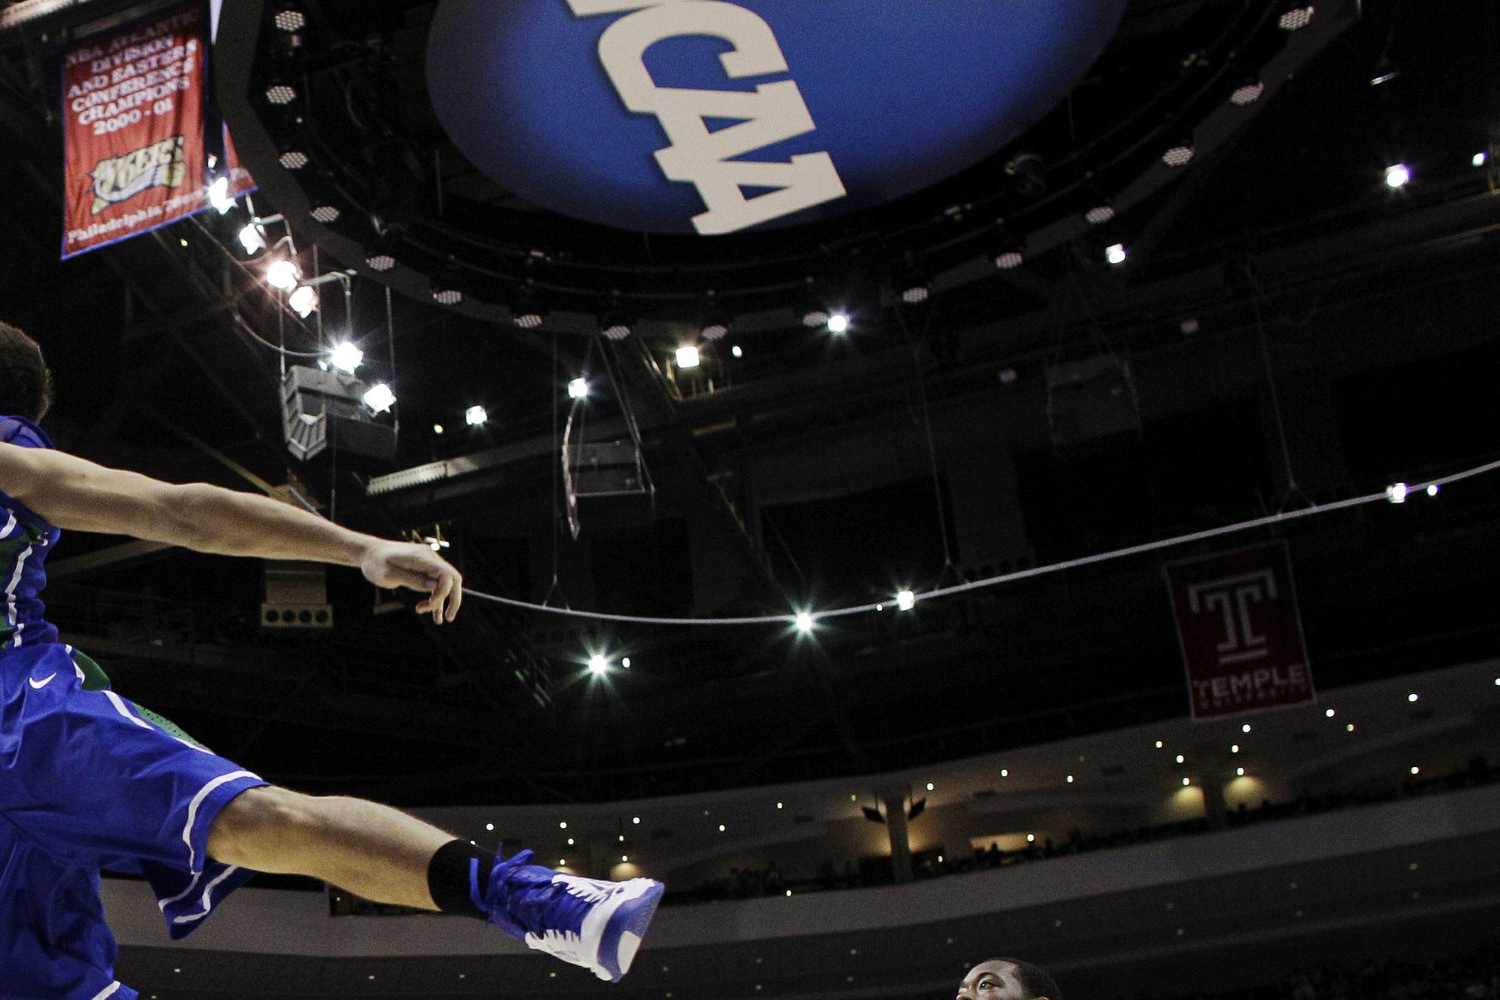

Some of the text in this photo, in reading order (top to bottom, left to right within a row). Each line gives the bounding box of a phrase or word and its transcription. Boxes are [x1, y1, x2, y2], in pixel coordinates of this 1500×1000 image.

[68, 38, 198, 99] AND EASTERN
[71, 56, 195, 113] CONFERENCE
[78, 76, 190, 126] CHAMPIONS
[564, 0, 847, 236] CAA
[1193, 663, 1306, 702] TEMPLE
